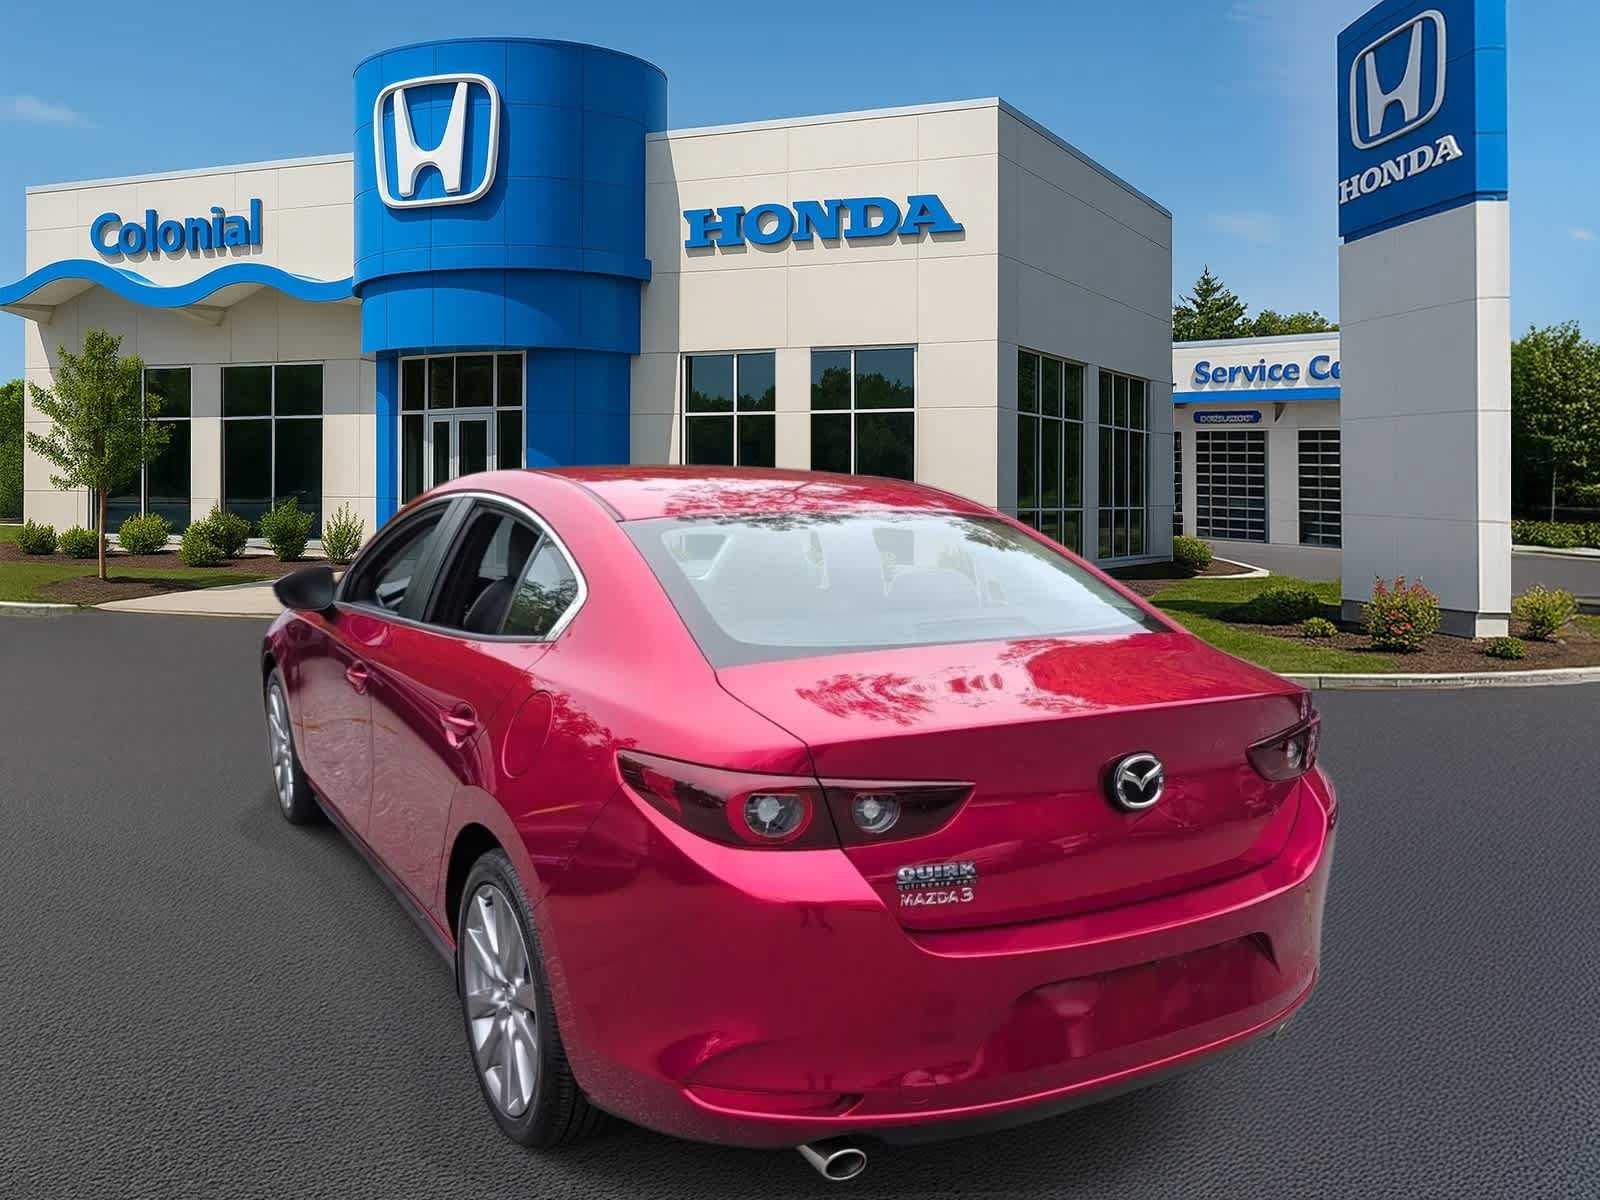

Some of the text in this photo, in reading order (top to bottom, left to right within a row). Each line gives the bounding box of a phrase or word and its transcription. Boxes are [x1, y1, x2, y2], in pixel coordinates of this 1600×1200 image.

[1338, 134, 1463, 204] HONDA
[90, 198, 263, 257] Colonial
[683, 194, 964, 249] HONDA
[1194, 358, 1300, 385] Service
[898, 862, 976, 880] QUIRK
